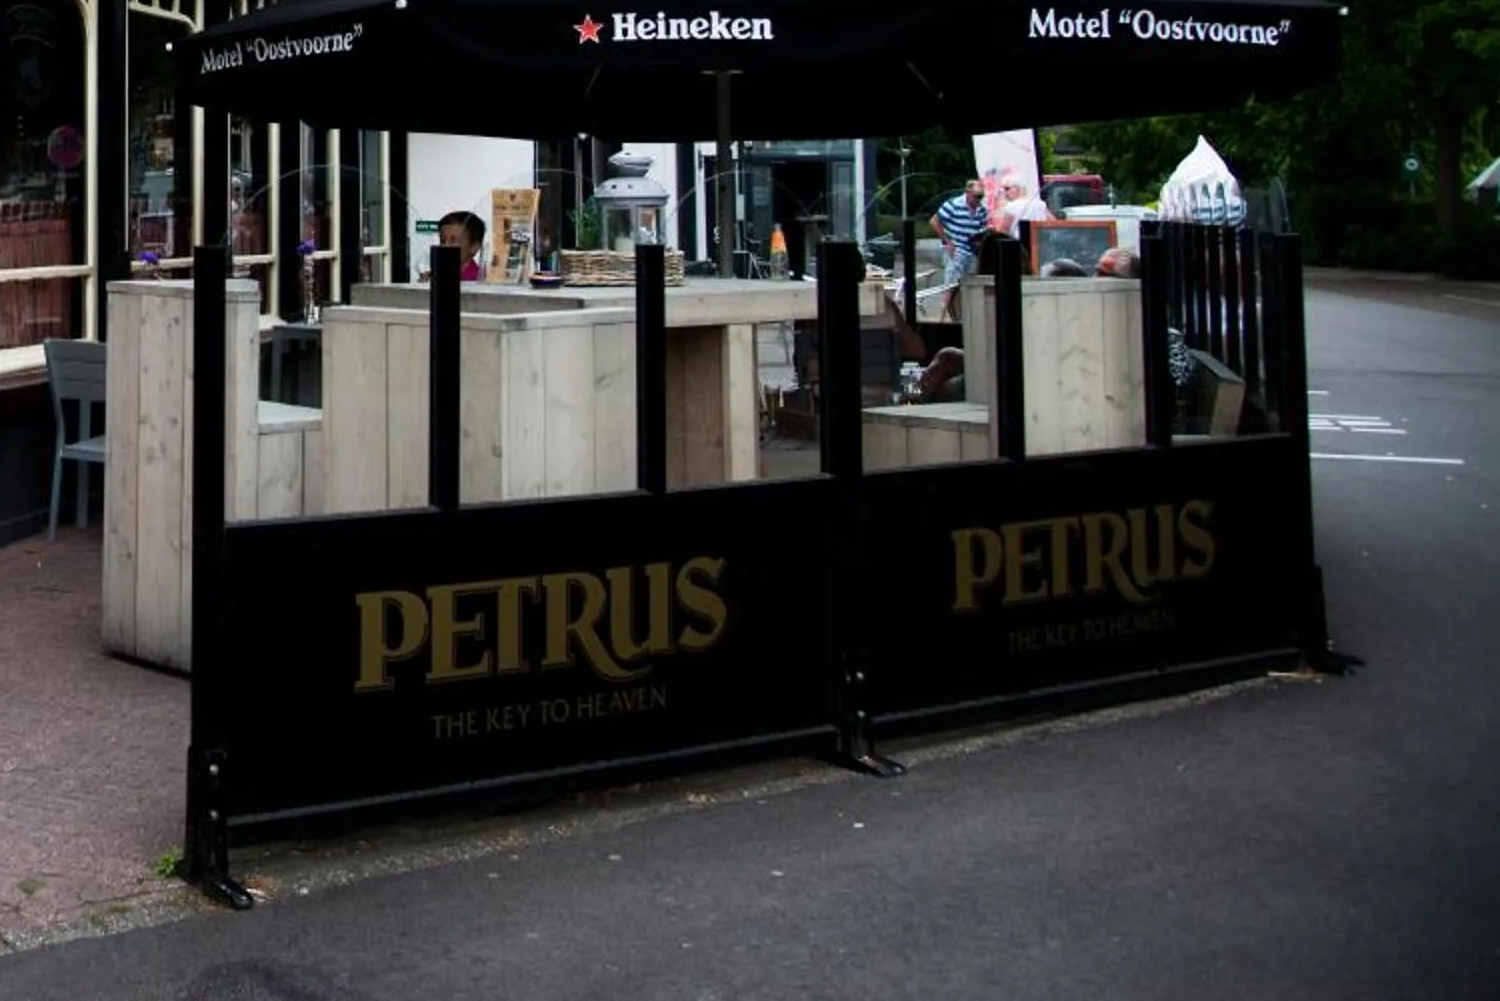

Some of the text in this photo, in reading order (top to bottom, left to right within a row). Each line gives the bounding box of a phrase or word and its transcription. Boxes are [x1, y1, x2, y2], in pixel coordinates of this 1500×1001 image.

[611, 10, 775, 42] Heineken
[1028, 7, 1111, 39] Motel
[200, 41, 243, 75] Motel
[949, 498, 1218, 616] PETRUS
[353, 554, 730, 695] PETRUS
[1007, 626, 1041, 656] THE
[1045, 620, 1079, 649] KEY
[1081, 616, 1106, 644] TO
[430, 681, 668, 741] THE KEY TO HEAVEN
